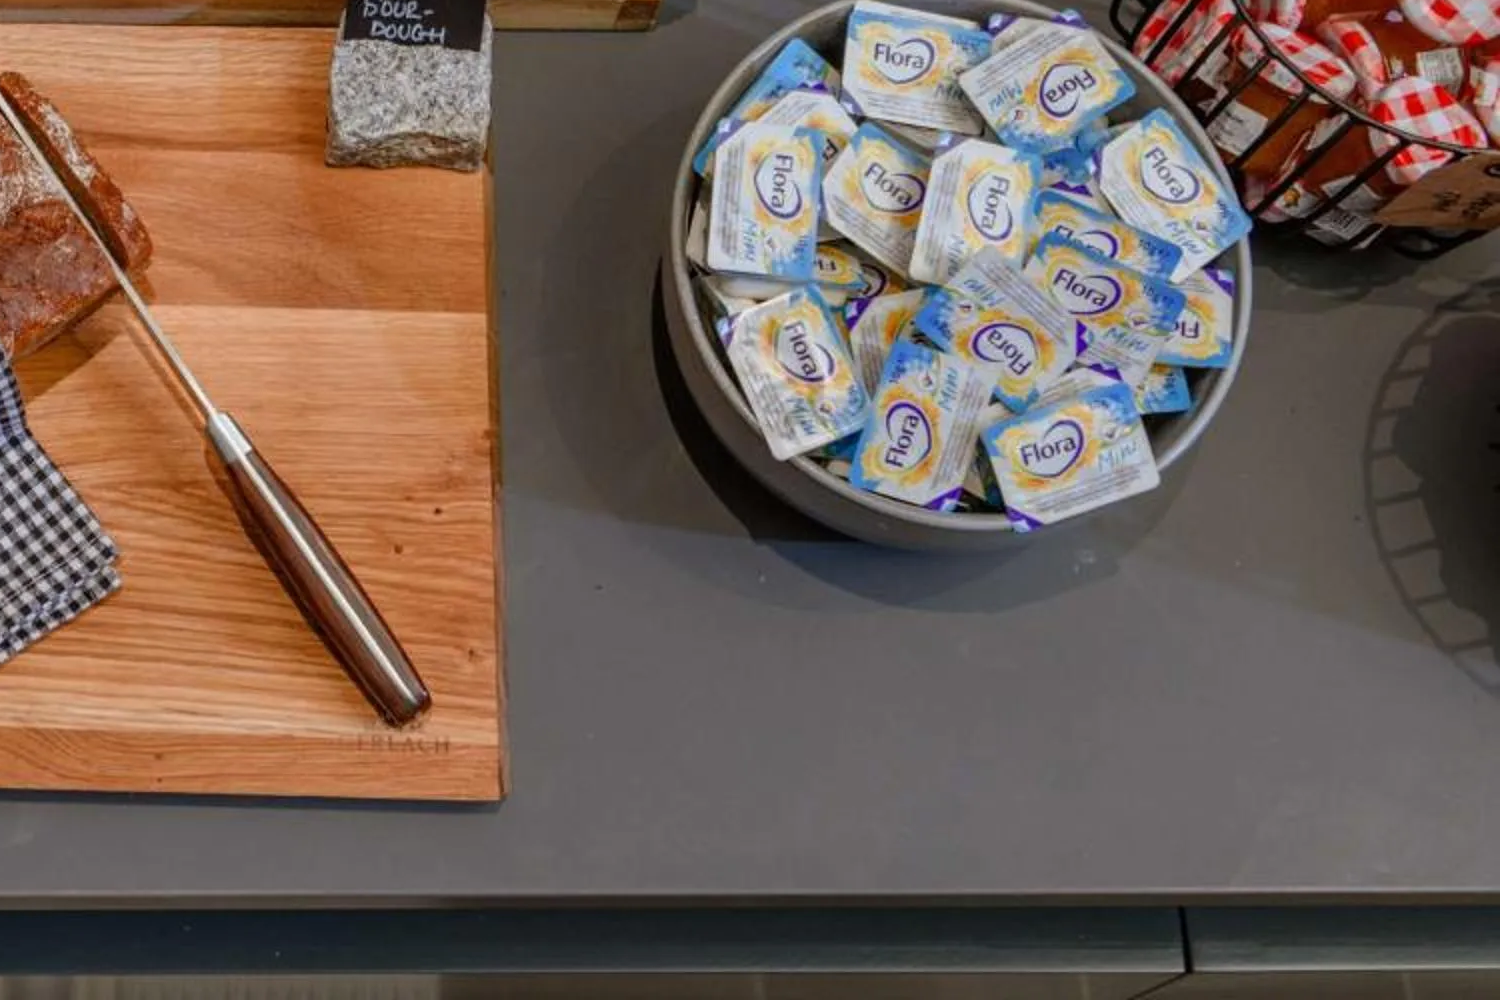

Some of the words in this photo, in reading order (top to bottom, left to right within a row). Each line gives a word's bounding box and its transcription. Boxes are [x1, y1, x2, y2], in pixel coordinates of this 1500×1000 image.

[370, 20, 445, 44] DOUGH
[873, 43, 925, 69] Flora
[1046, 68, 1097, 103] Flora
[771, 153, 795, 209] Flora
[864, 161, 913, 207] Flora
[1145, 146, 1185, 199] Flora
[981, 175, 1011, 230] Flora
[1053, 267, 1108, 306] Flora
[784, 319, 817, 376] Flora
[986, 328, 1032, 376] Flora
[885, 414, 920, 469] Flora
[1019, 436, 1077, 466] Flora
